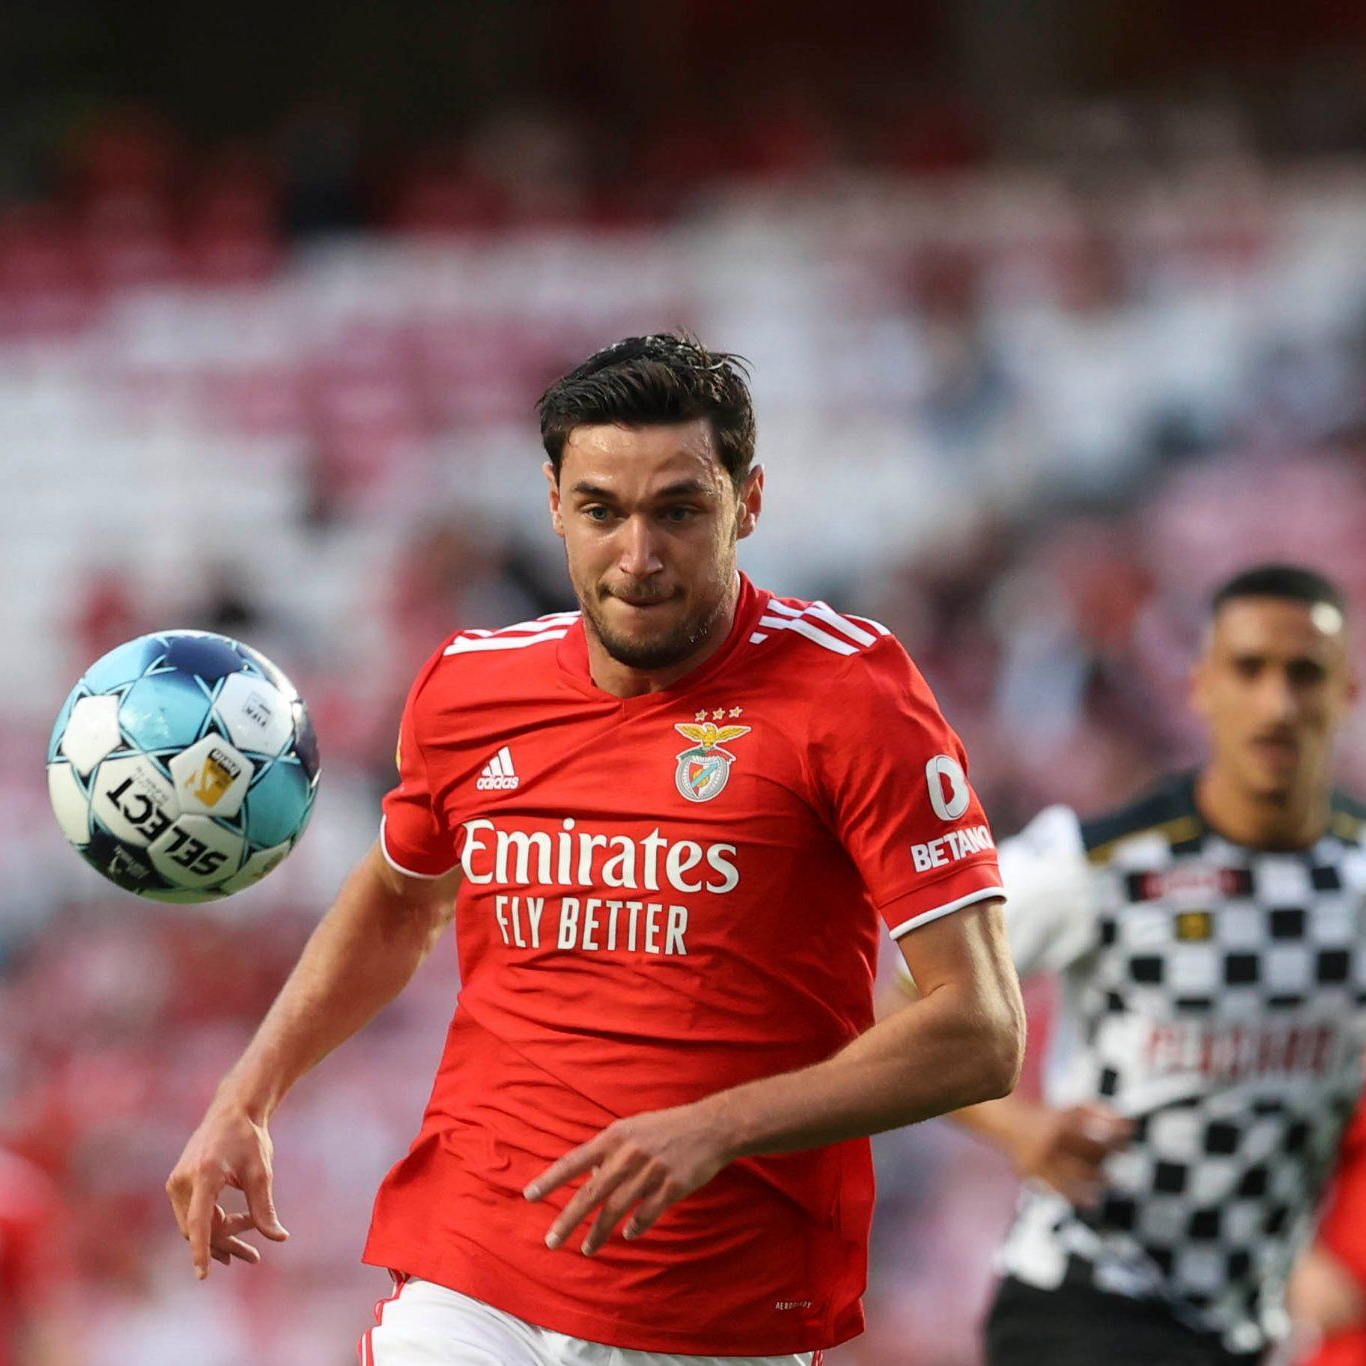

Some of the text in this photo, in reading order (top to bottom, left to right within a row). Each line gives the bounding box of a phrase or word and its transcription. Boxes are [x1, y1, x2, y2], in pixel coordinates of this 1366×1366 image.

[477, 775, 519, 790] adidas
[106, 778, 229, 876] SELECT
[461, 817, 740, 894] Emirates
[911, 825, 995, 873] BETANO
[496, 896, 689, 956] FLY BETTER
